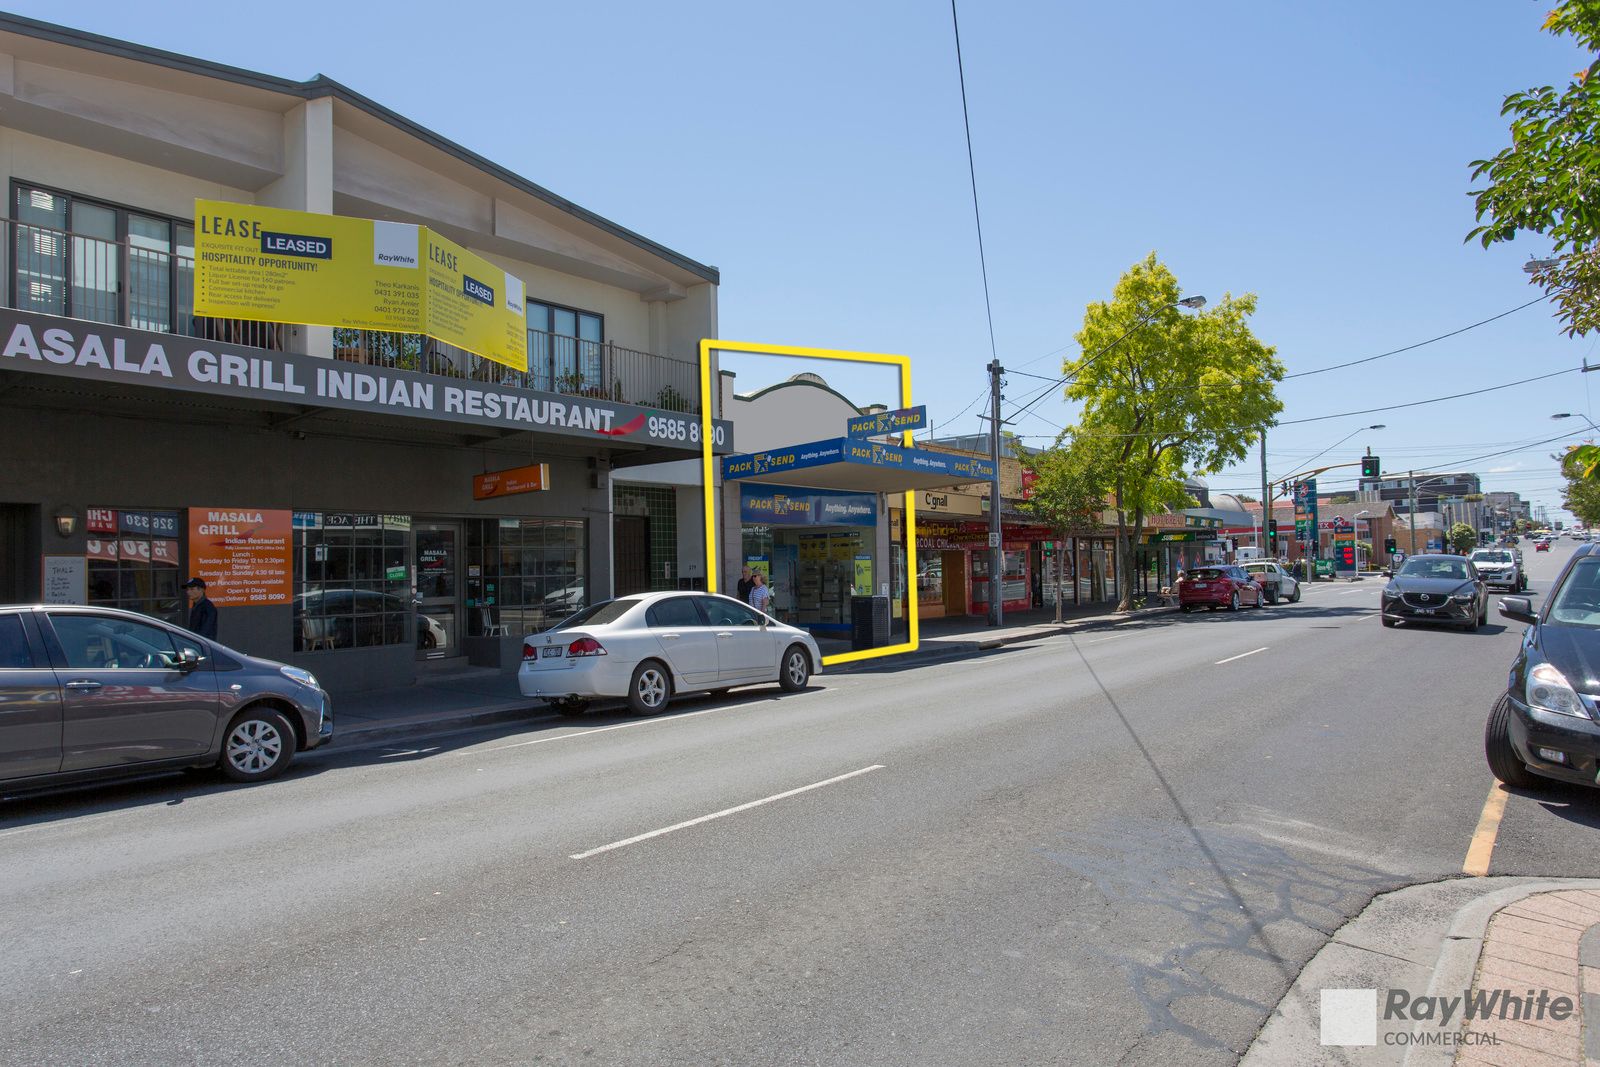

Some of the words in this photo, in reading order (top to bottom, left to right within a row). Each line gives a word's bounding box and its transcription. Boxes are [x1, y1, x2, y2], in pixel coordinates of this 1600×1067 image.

[202, 215, 261, 239] LEASE
[202, 242, 233, 250] EXQUISITE
[267, 237, 327, 254] LEASED
[202, 252, 256, 266] HOSPITALITY
[258, 257, 318, 272] OPPORTUNITY!
[378, 254, 415, 264] RayWhite
[429, 242, 458, 273] LEASE
[208, 272, 227, 280] Liquor
[208, 286, 244, 294] Commercial
[376, 280, 392, 288] Theo
[374, 289, 392, 297] 0431
[392, 290, 406, 298] 391
[406, 291, 420, 299] 035
[465, 280, 492, 302] LEASED
[374, 306, 392, 314] 0401
[392, 306, 406, 315] 971
[406, 308, 420, 316] 622
[187, 350, 306, 394] GRILL
[316, 368, 433, 410] INDIAN
[444, 386, 615, 432] RESTAURANT
[648, 416, 686, 441] 9585
[852, 420, 874, 432] PACK
[894, 414, 920, 426] SEND
[852, 447, 871, 458] PACK
[885, 452, 902, 462] SEND
[729, 461, 752, 474] PACK
[770, 454, 795, 466] SEND
[954, 462, 969, 472] PACK
[980, 466, 993, 475] SEND
[750, 500, 772, 510] PACK
[790, 501, 810, 511] SEND
[824, 503, 848, 514] Anything.
[848, 504, 872, 514] Anywhere.
[208, 512, 263, 523] MASALA
[198, 524, 240, 536] GRILL
